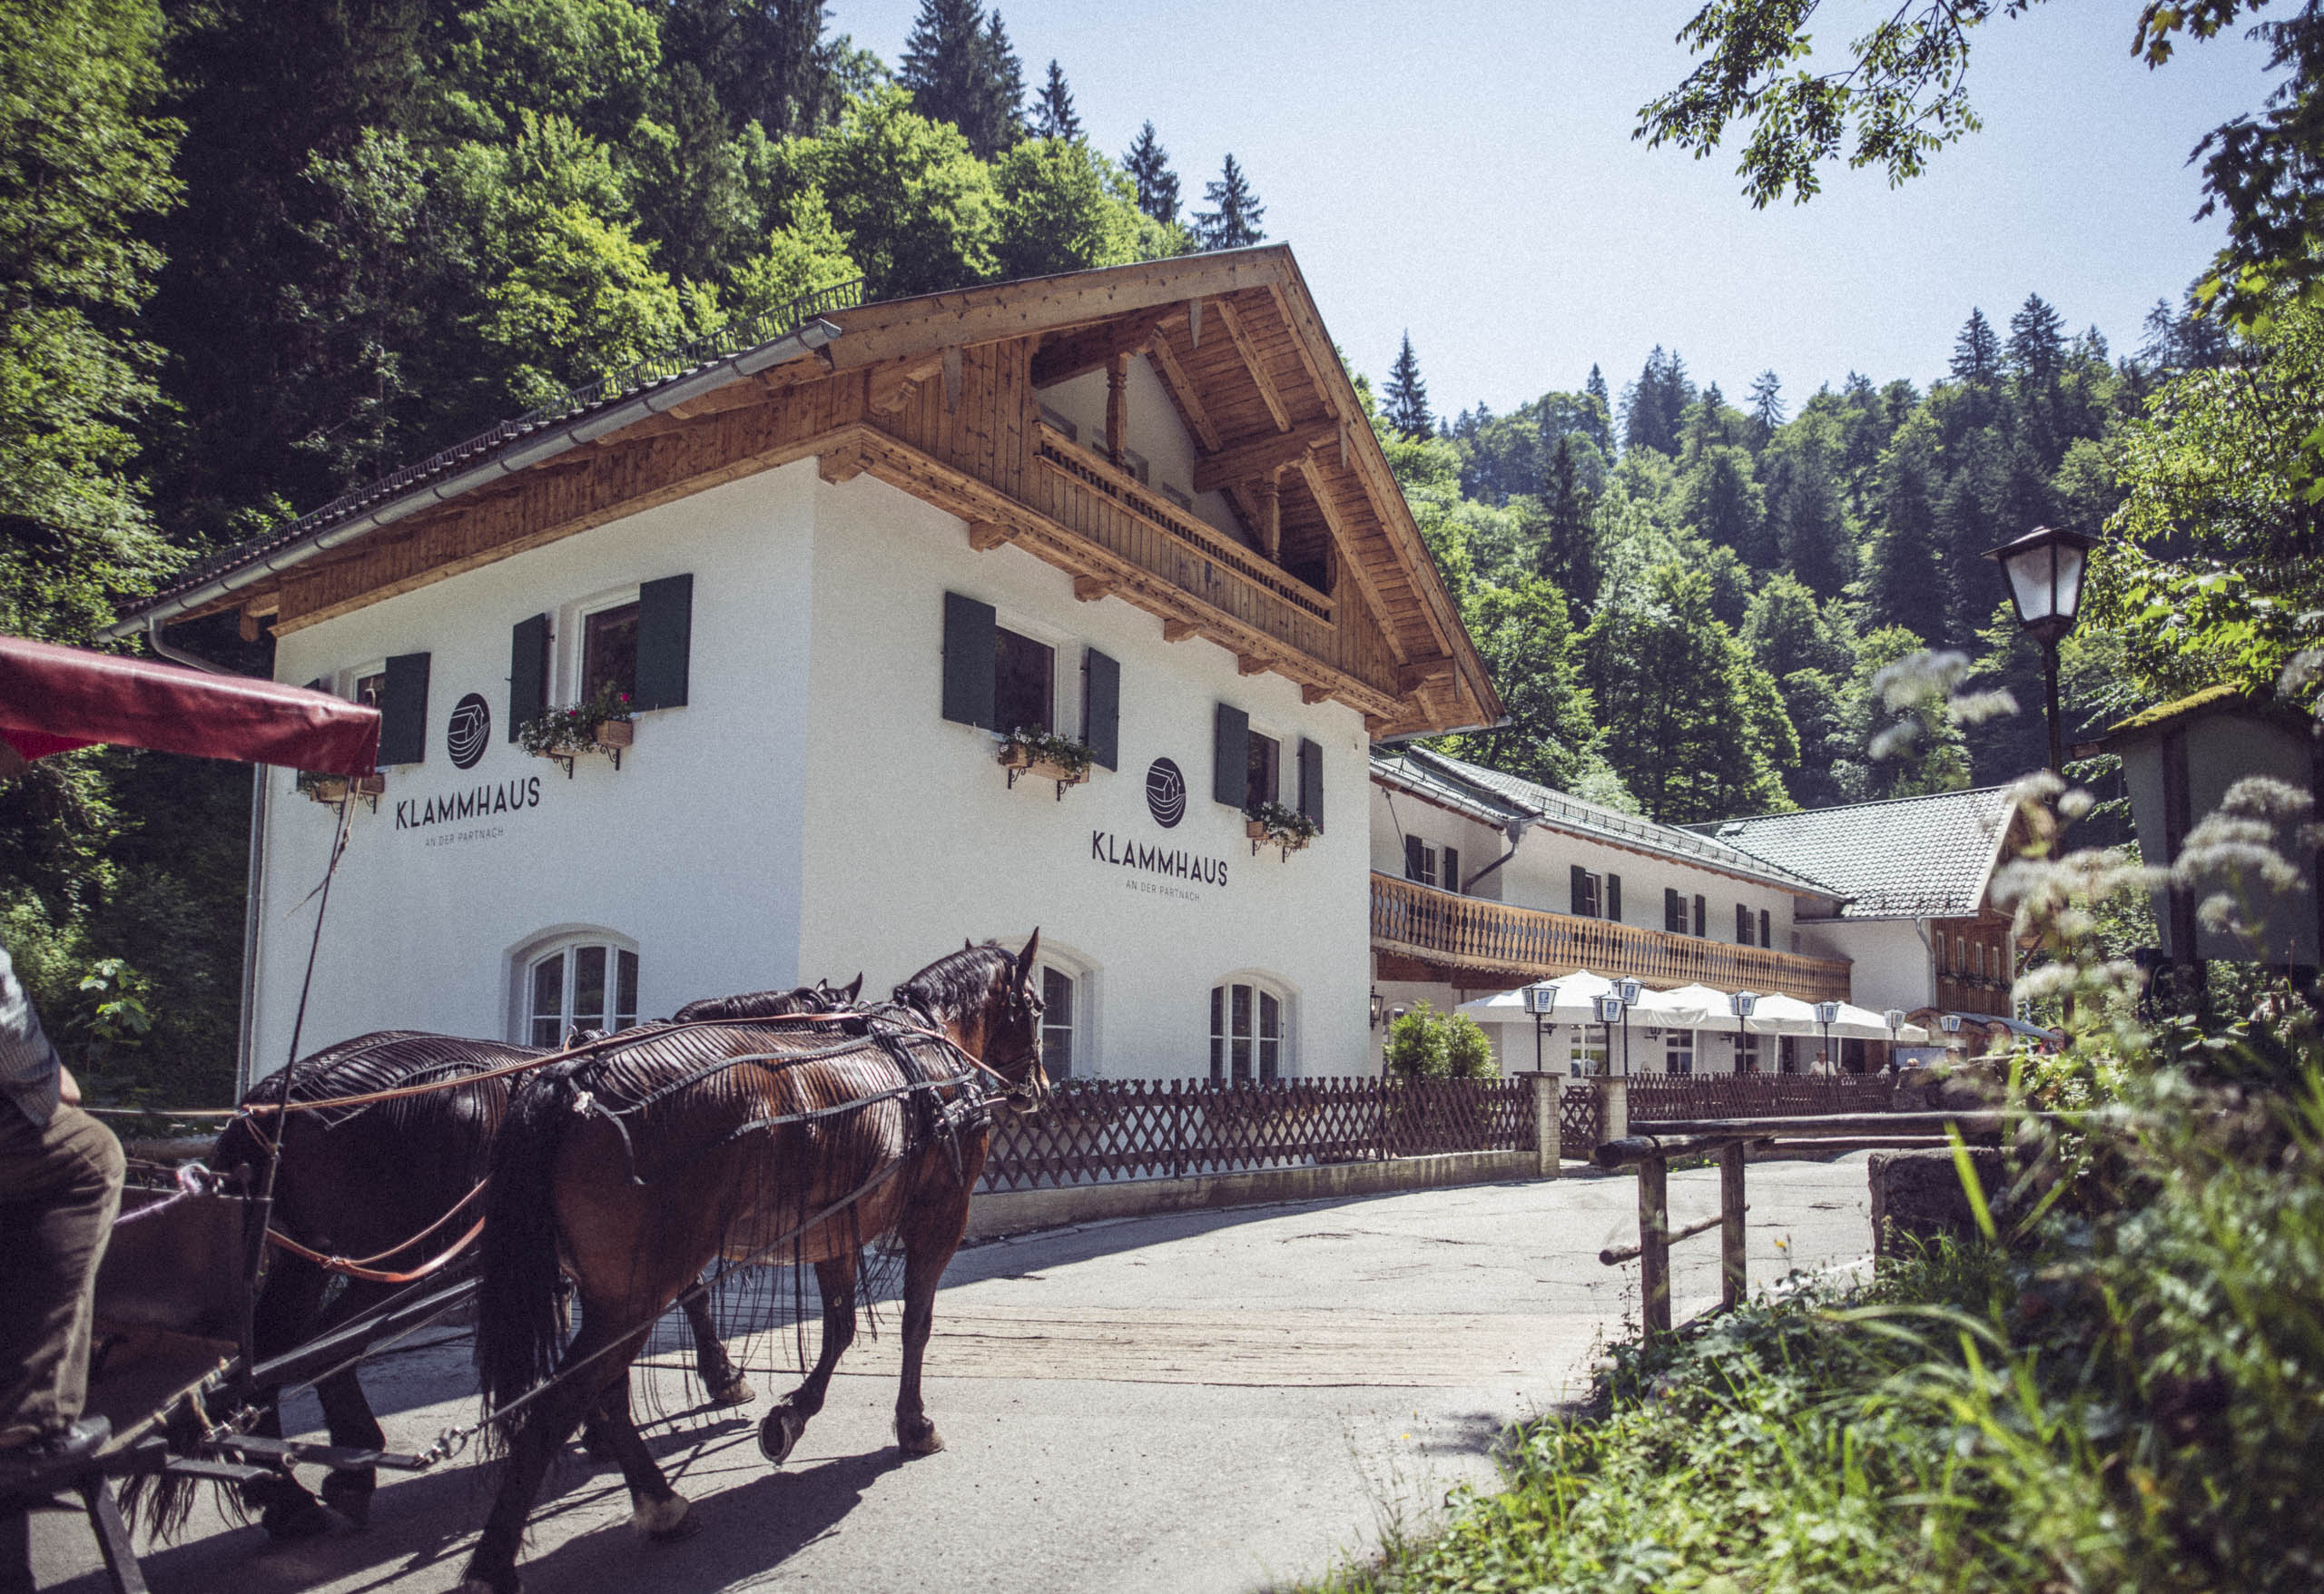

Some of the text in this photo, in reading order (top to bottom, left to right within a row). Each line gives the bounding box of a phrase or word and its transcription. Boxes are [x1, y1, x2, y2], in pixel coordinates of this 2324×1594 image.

[396, 776, 540, 830] KLAMMHAUS
[425, 827, 504, 847] AN DER PARTNACH
[1092, 830, 1227, 887] KLAMMHAUS
[1126, 879, 1200, 901] AN DER PARTNACH
